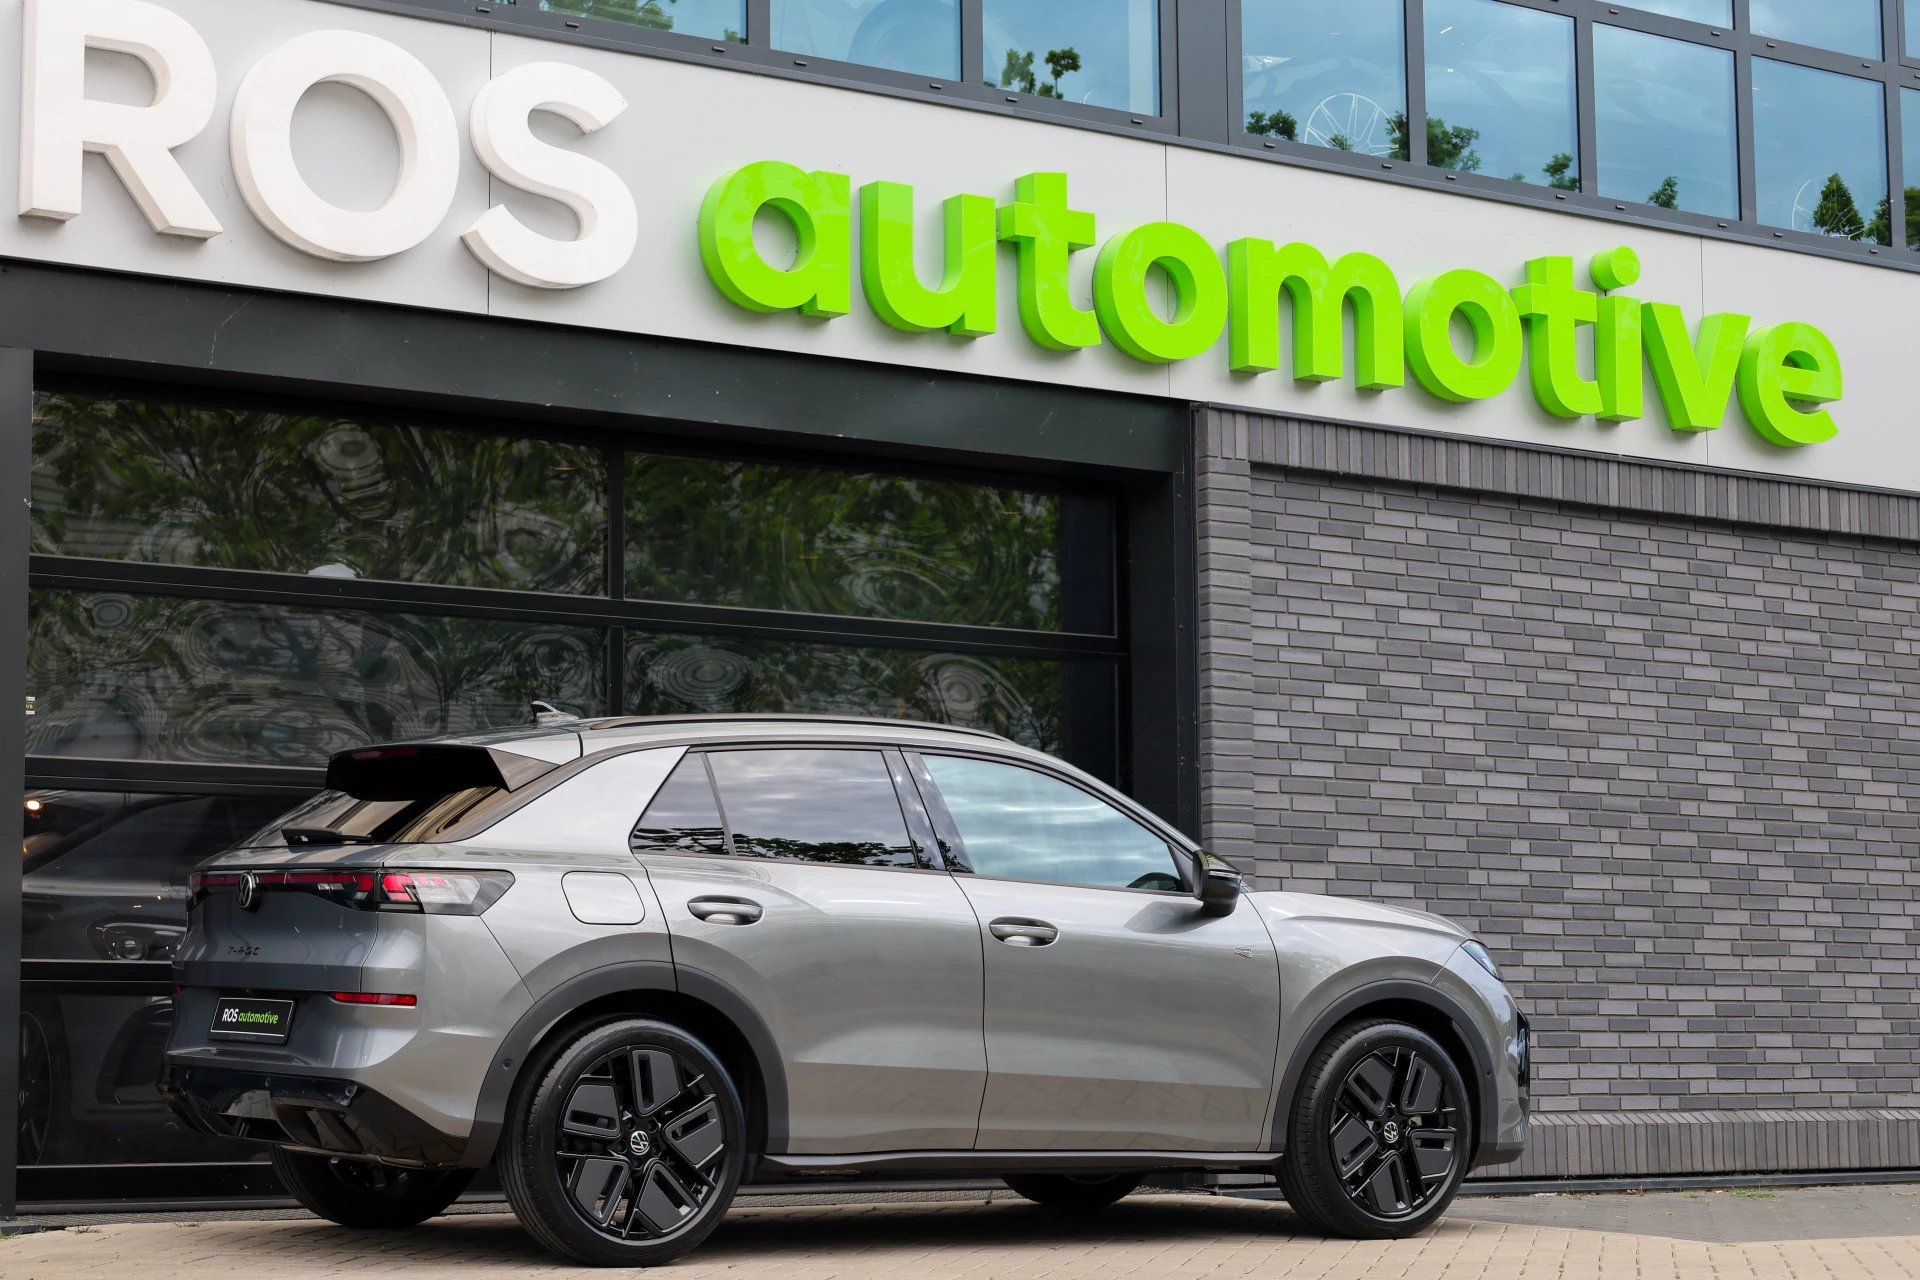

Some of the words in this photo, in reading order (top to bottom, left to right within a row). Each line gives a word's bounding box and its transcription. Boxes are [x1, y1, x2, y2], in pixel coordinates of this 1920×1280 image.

[19, 0, 639, 289] ROS
[698, 160, 1843, 449] automotive
[221, 1008, 239, 1023] ROS
[238, 1010, 279, 1025] automotive
